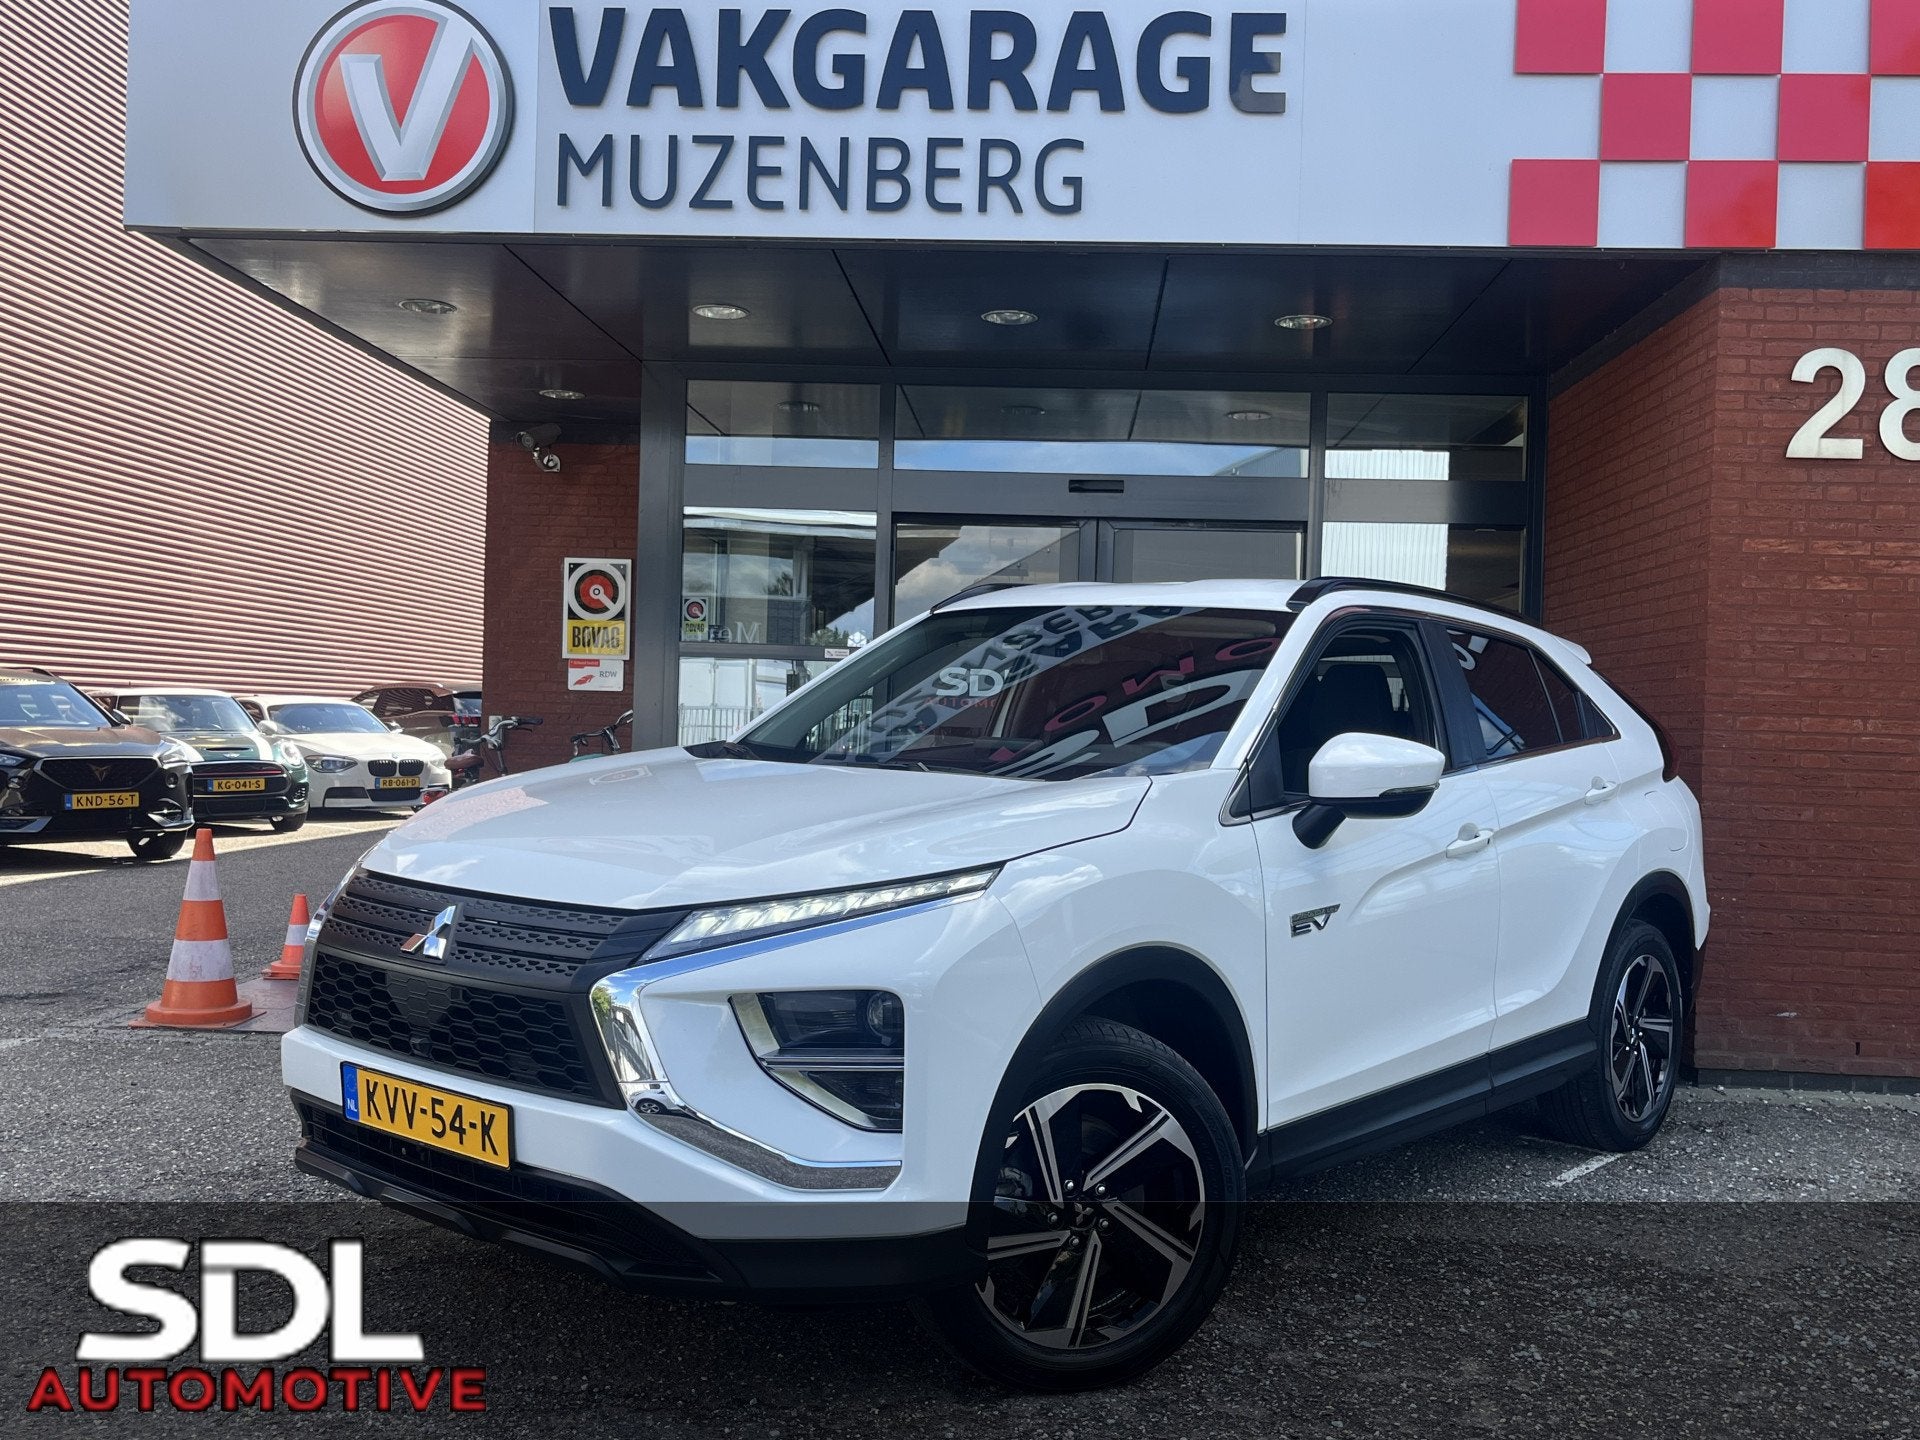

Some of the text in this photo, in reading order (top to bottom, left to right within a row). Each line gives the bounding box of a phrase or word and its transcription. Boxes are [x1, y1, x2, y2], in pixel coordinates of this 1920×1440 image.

[549, 7, 1287, 115] VAKGARAGE
[557, 133, 1085, 215] MUZENBERG
[572, 625, 620, 648] BOVAG
[599, 670, 617, 678] RDW
[936, 666, 1010, 697] SD
[217, 780, 261, 790] KG-041-S
[76, 794, 136, 807] KND-56-T
[1289, 903, 1341, 938] EV
[347, 1097, 358, 1112] NL
[365, 1078, 499, 1156] KVV-54-K
